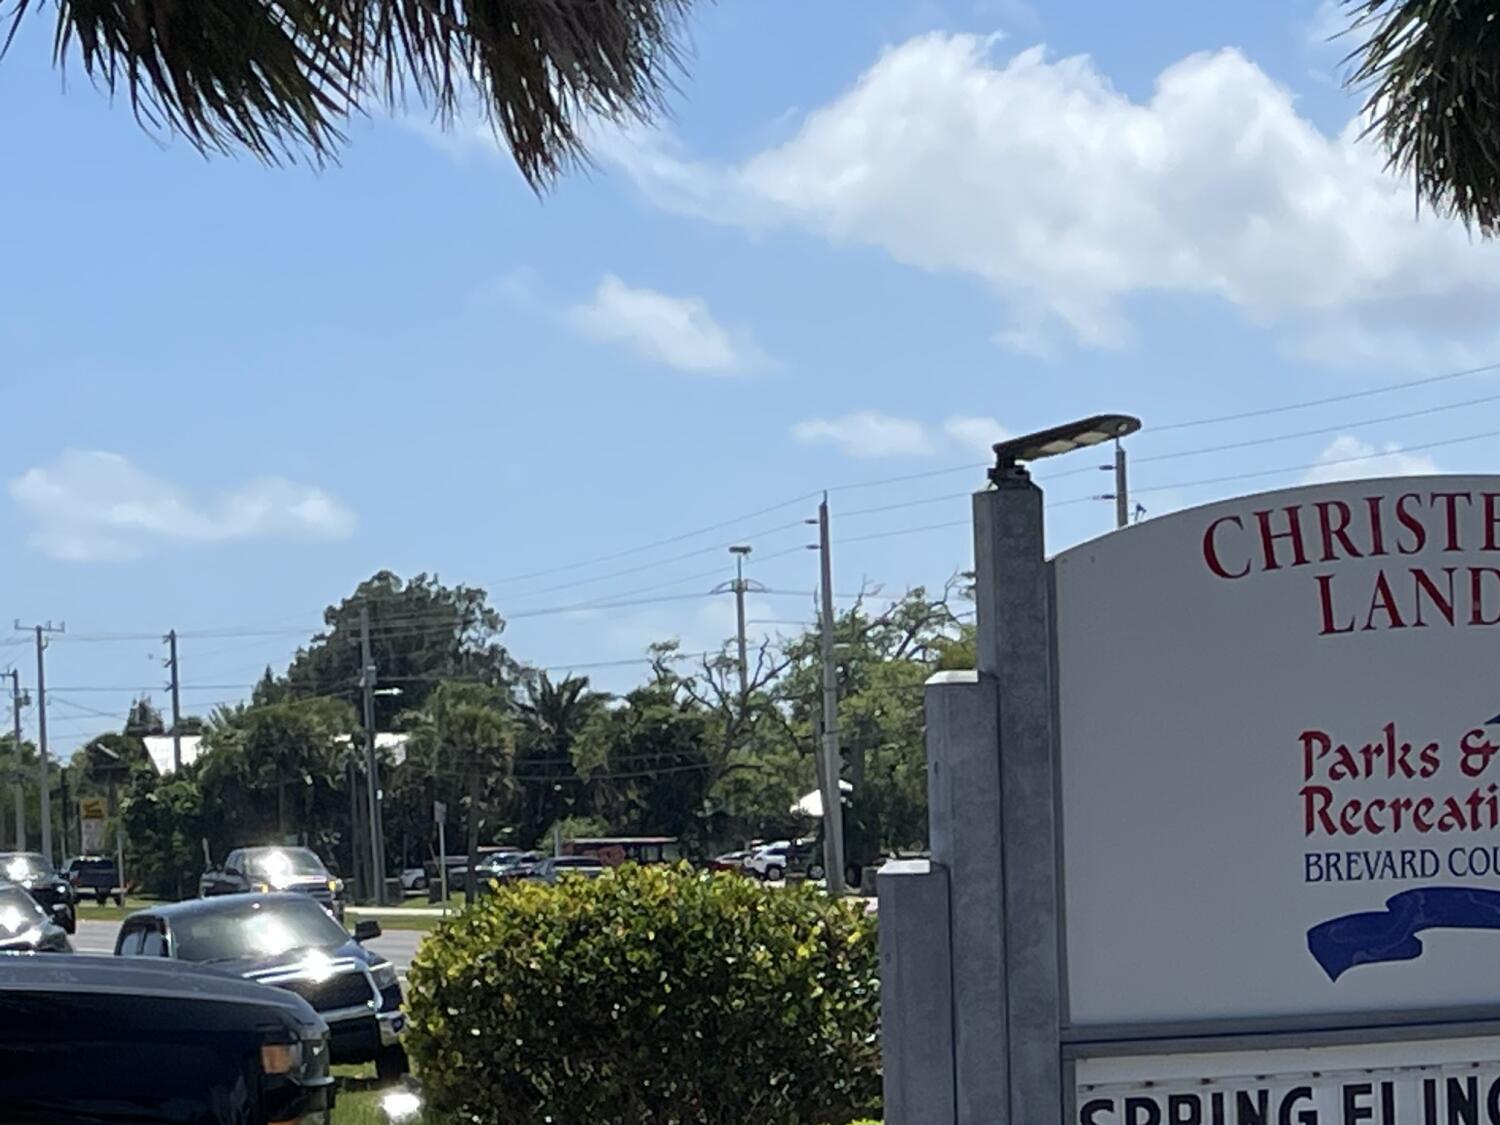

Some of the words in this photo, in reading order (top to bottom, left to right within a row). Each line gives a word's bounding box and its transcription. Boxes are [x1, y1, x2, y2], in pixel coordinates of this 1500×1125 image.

[1298, 722, 1440, 782] Parks
[1459, 729, 1500, 778] &
[1304, 848, 1441, 883] BREVARD
